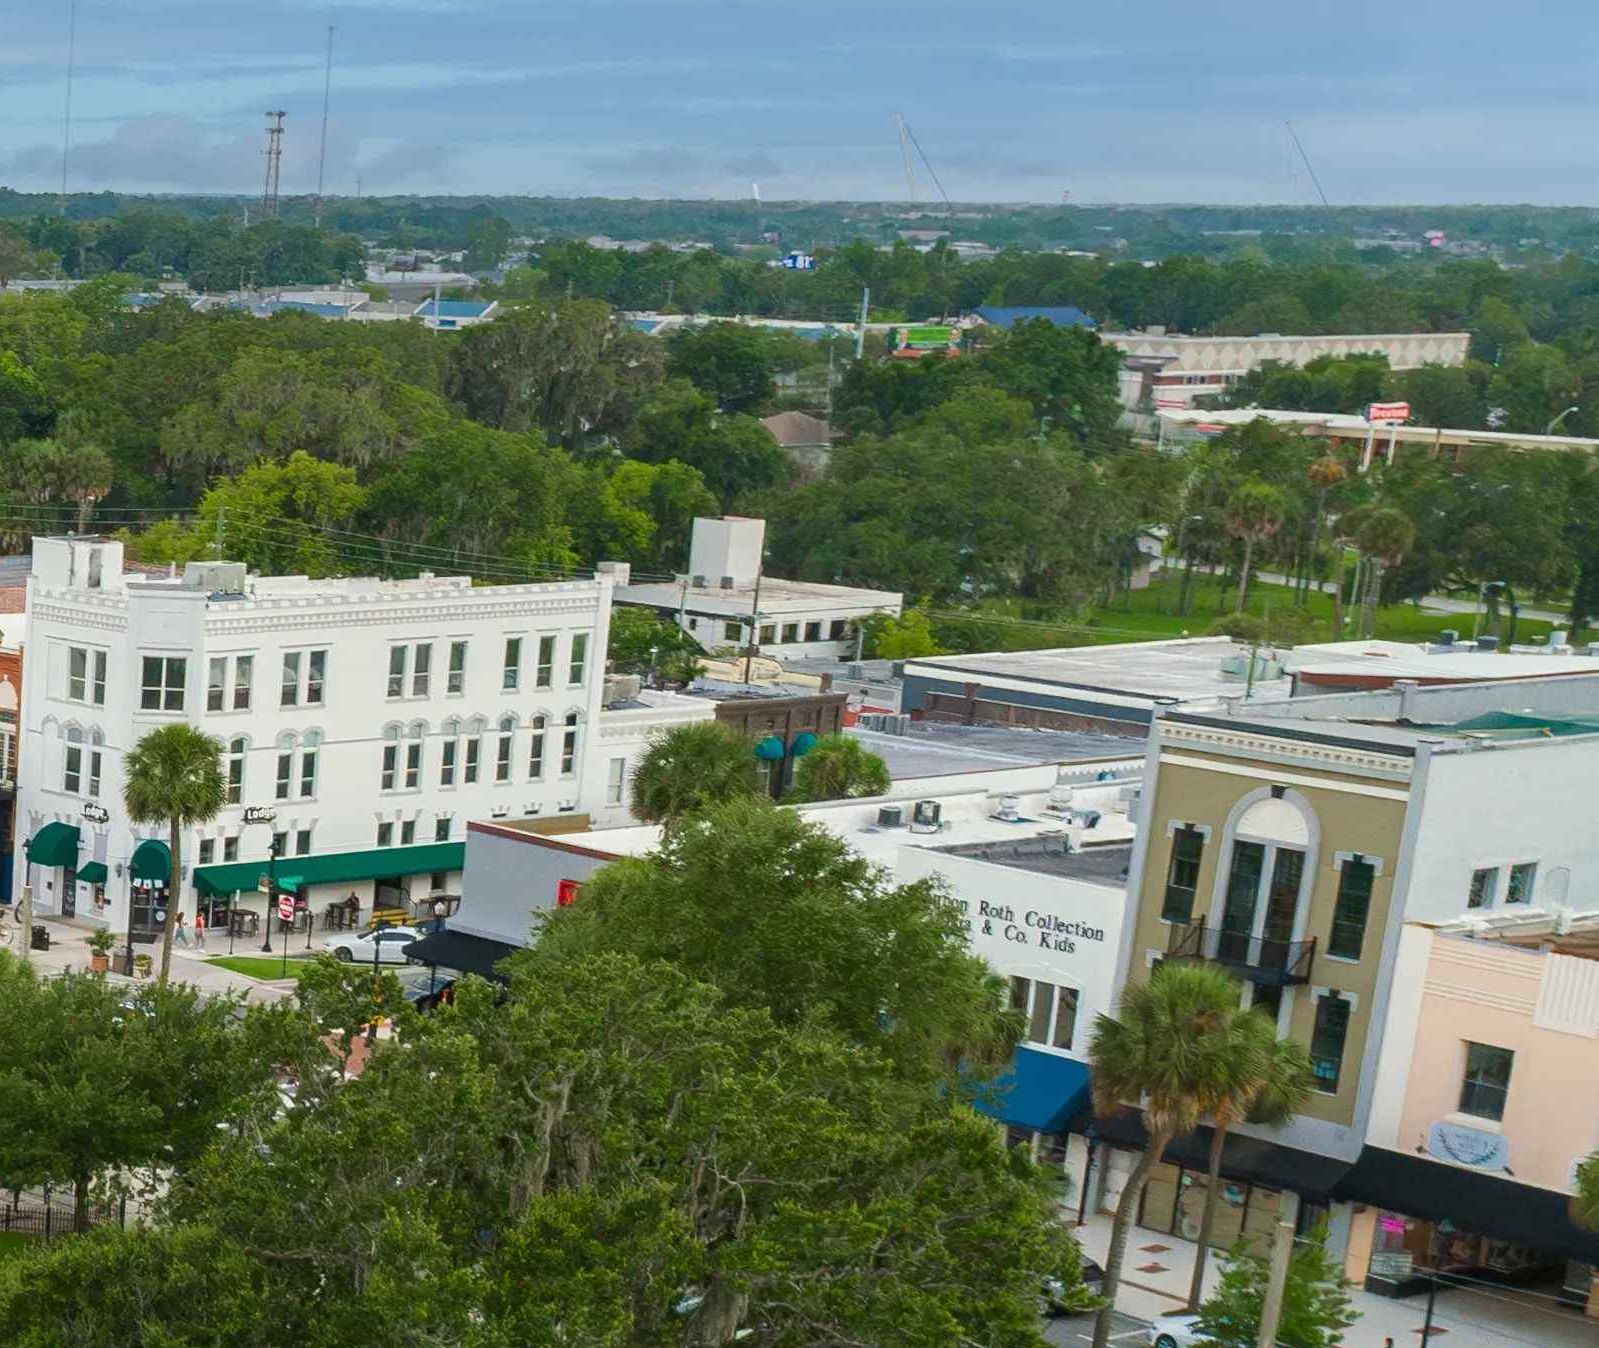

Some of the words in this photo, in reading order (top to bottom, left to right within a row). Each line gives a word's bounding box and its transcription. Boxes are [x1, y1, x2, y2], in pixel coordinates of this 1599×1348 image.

[979, 900, 1014, 922] Roth
[1025, 911, 1104, 942] Collection
[982, 919, 994, 936] &
[1004, 925, 1028, 944] Co.
[1039, 932, 1076, 953] Kids
